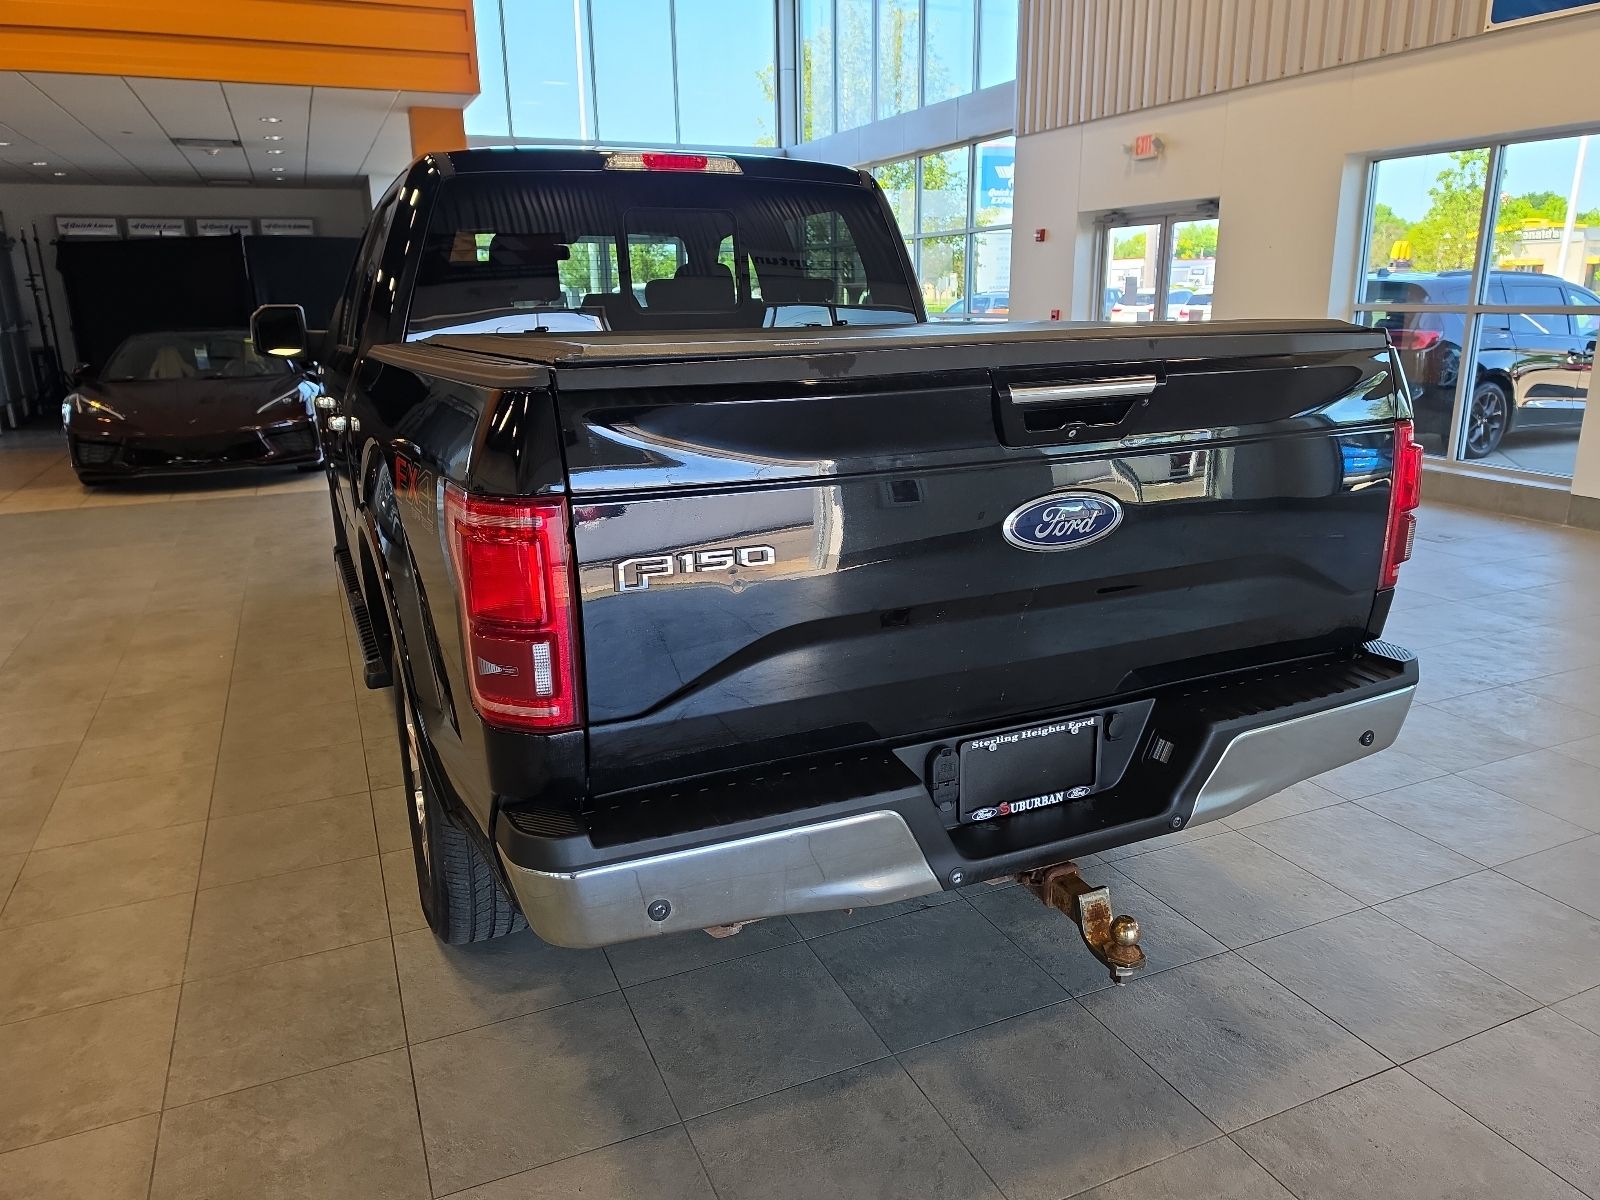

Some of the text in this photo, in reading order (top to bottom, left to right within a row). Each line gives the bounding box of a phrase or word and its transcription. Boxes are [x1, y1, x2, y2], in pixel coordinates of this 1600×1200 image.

[1136, 135, 1152, 155] EXIT
[1034, 504, 1098, 539] Ford
[613, 544, 776, 592] F150
[971, 717, 1095, 749] Sterling Heights Ford
[975, 808, 994, 820] Ford
[1000, 791, 1065, 816] SUBURBAN
